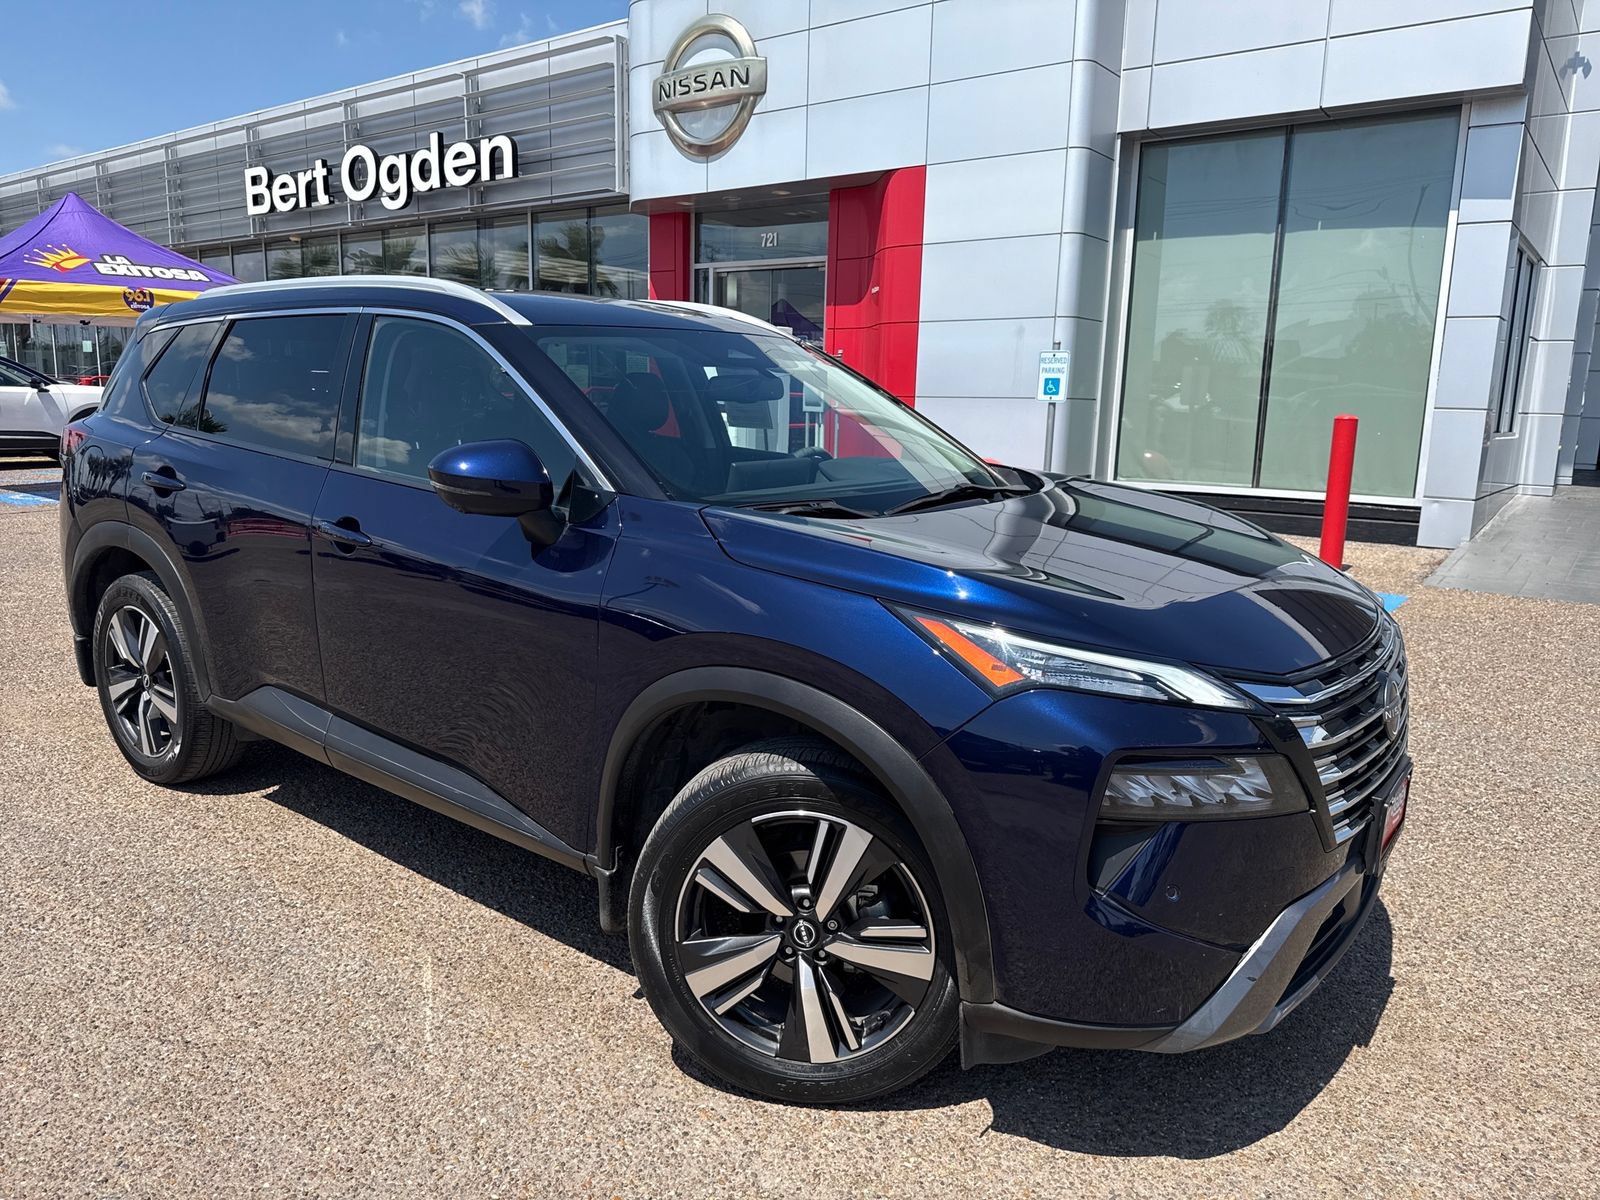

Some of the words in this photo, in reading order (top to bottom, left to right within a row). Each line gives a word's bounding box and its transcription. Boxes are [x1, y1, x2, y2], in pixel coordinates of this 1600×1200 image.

[659, 66, 750, 102] NISSAN
[244, 158, 330, 216] Bert
[341, 131, 515, 210] Ogden
[760, 231, 778, 248] 721
[102, 254, 132, 265] LA
[93, 262, 211, 282] EXITOSA
[124, 288, 151, 303] 96.1
